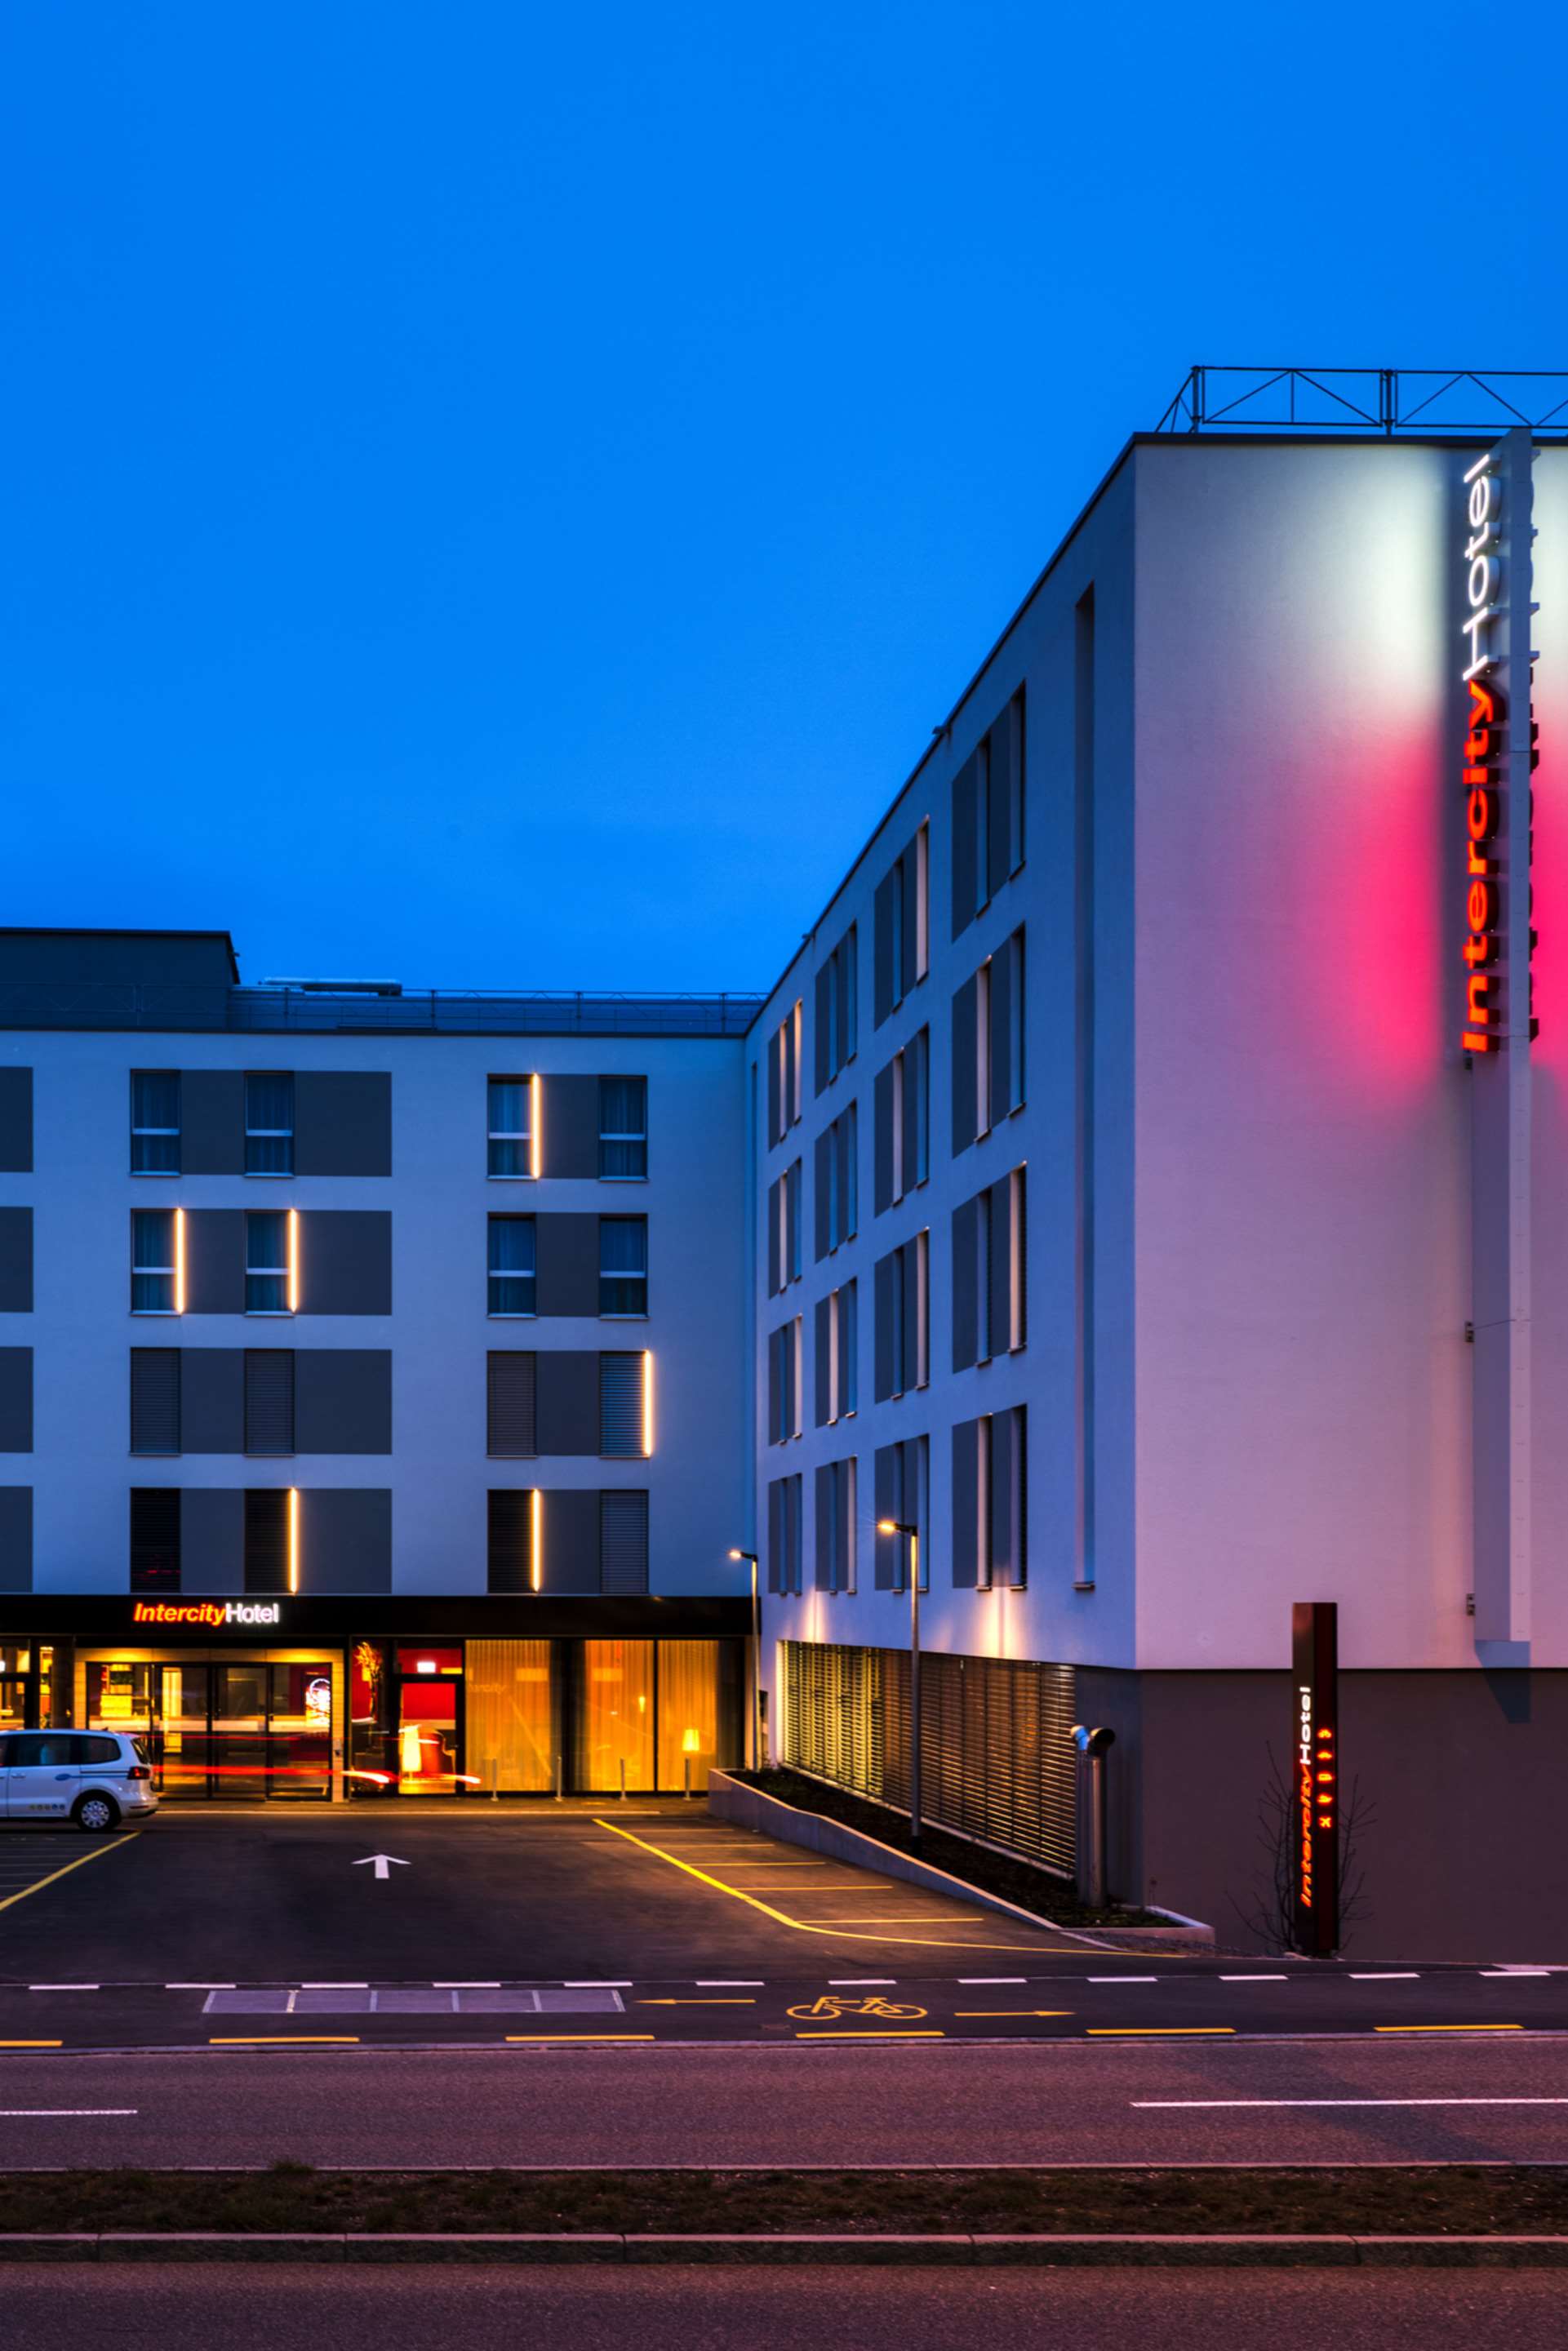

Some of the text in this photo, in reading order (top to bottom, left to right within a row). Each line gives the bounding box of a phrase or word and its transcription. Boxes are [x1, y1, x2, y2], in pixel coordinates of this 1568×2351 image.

[1463, 454, 1493, 1052] IntercityHotel
[133, 1602, 279, 1626] IntercityHotel
[1299, 1687, 1313, 1907] IntercityHotel
